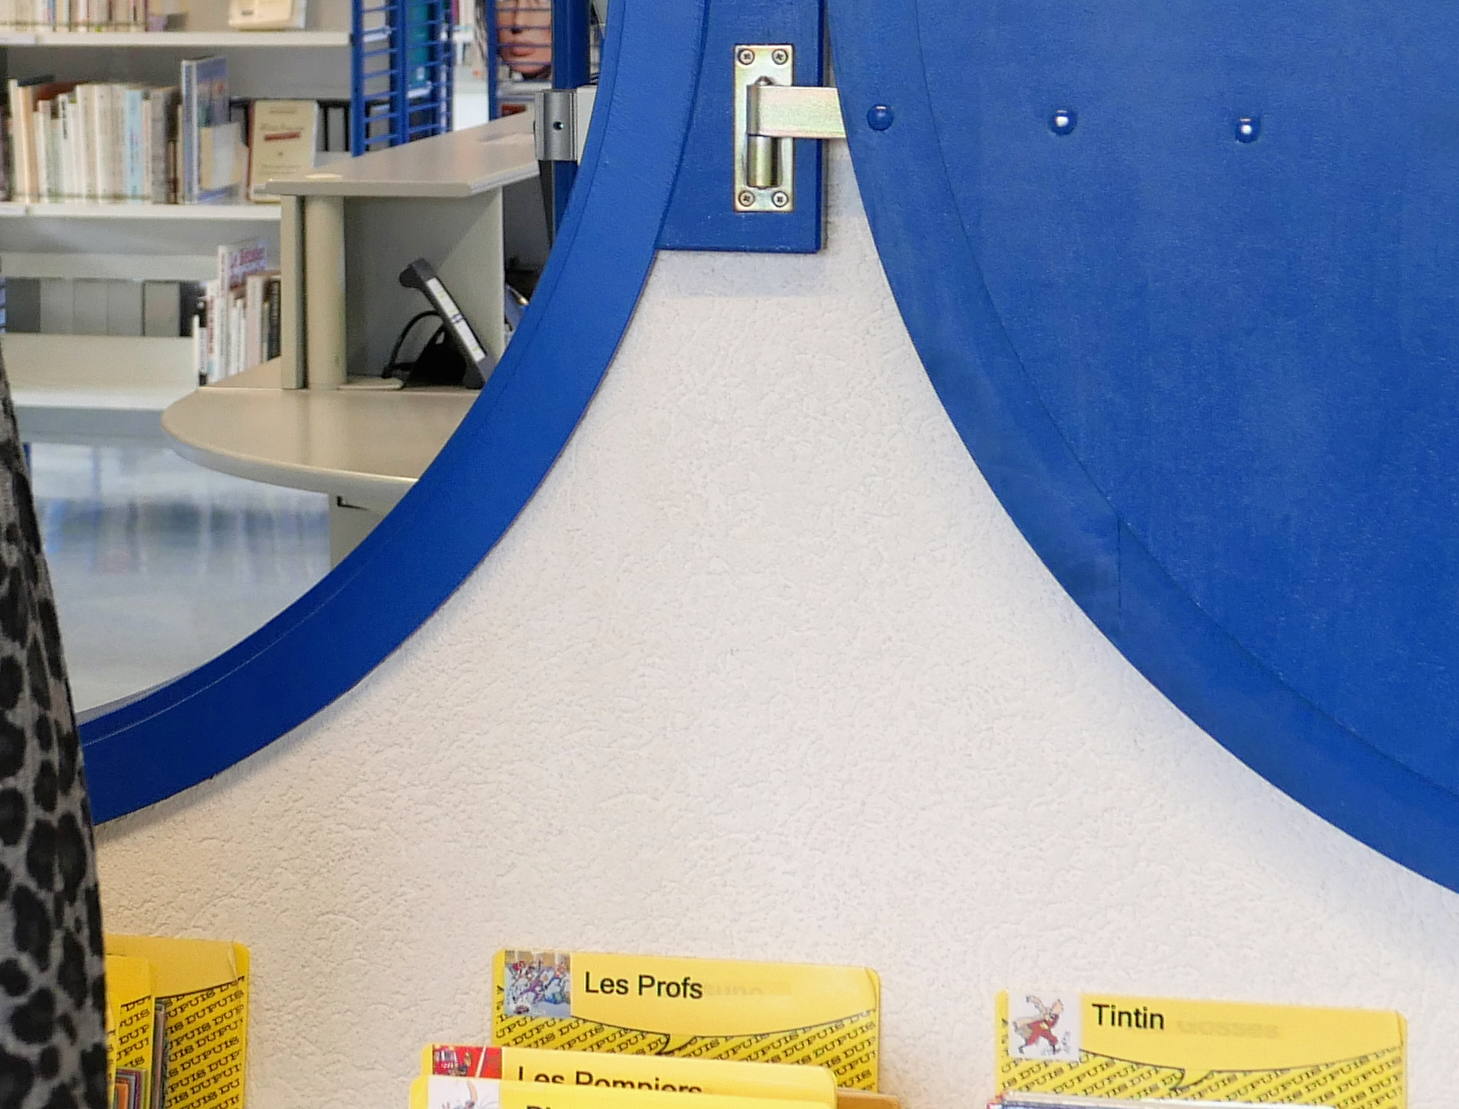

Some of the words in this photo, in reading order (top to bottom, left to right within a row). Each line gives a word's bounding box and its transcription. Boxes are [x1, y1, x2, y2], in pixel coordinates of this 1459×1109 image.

[585, 971, 629, 995] Les
[638, 974, 703, 999] Profs
[185, 990, 244, 1024] DUPUIS
[1091, 1003, 1165, 1030] Tintin
[180, 1036, 240, 1070] DUPUIS
[783, 1022, 845, 1057] DUPUIS
[813, 1021, 876, 1058] DUPUIS
